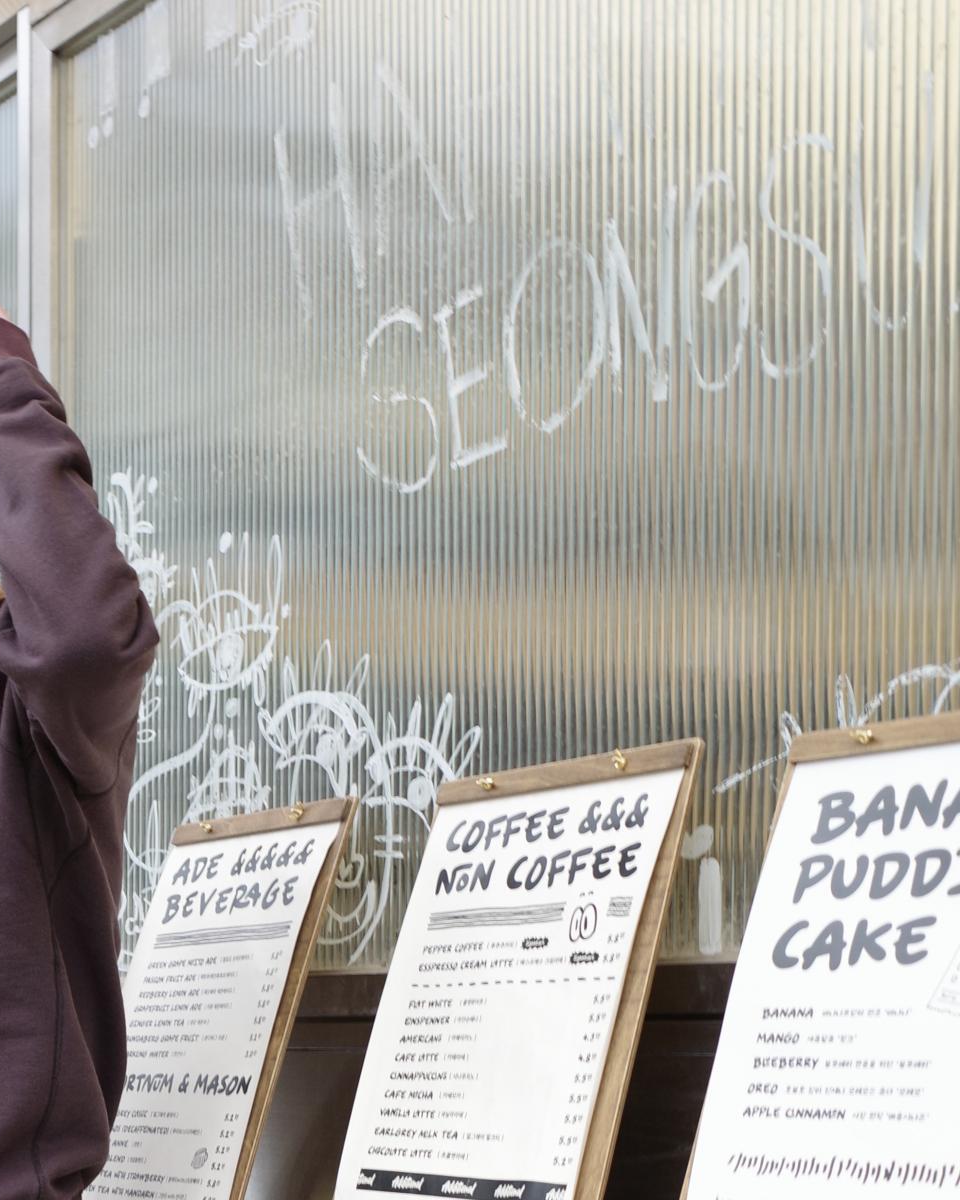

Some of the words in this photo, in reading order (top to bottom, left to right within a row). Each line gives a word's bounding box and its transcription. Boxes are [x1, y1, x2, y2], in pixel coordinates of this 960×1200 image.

[446, 806, 570, 853] COFFEE
[171, 853, 224, 885] ADE
[506, 842, 642, 891] COFFEE
[162, 876, 299, 924] BEVERAGE
[454, 941, 484, 953] COFFEE
[772, 916, 937, 971] CAKE
[460, 959, 487, 970] CREAM
[762, 1007, 814, 1020] BANANA
[756, 1032, 800, 1044] MANGO
[394, 1052, 416, 1062] CAFE
[177, 1073, 190, 1094] &
[193, 1074, 252, 1096] MASON
[747, 1082, 779, 1094] OREO
[384, 1089, 406, 1099] CAFE
[742, 1105, 781, 1118] APPLE
[442, 1130, 458, 1140] TEA
